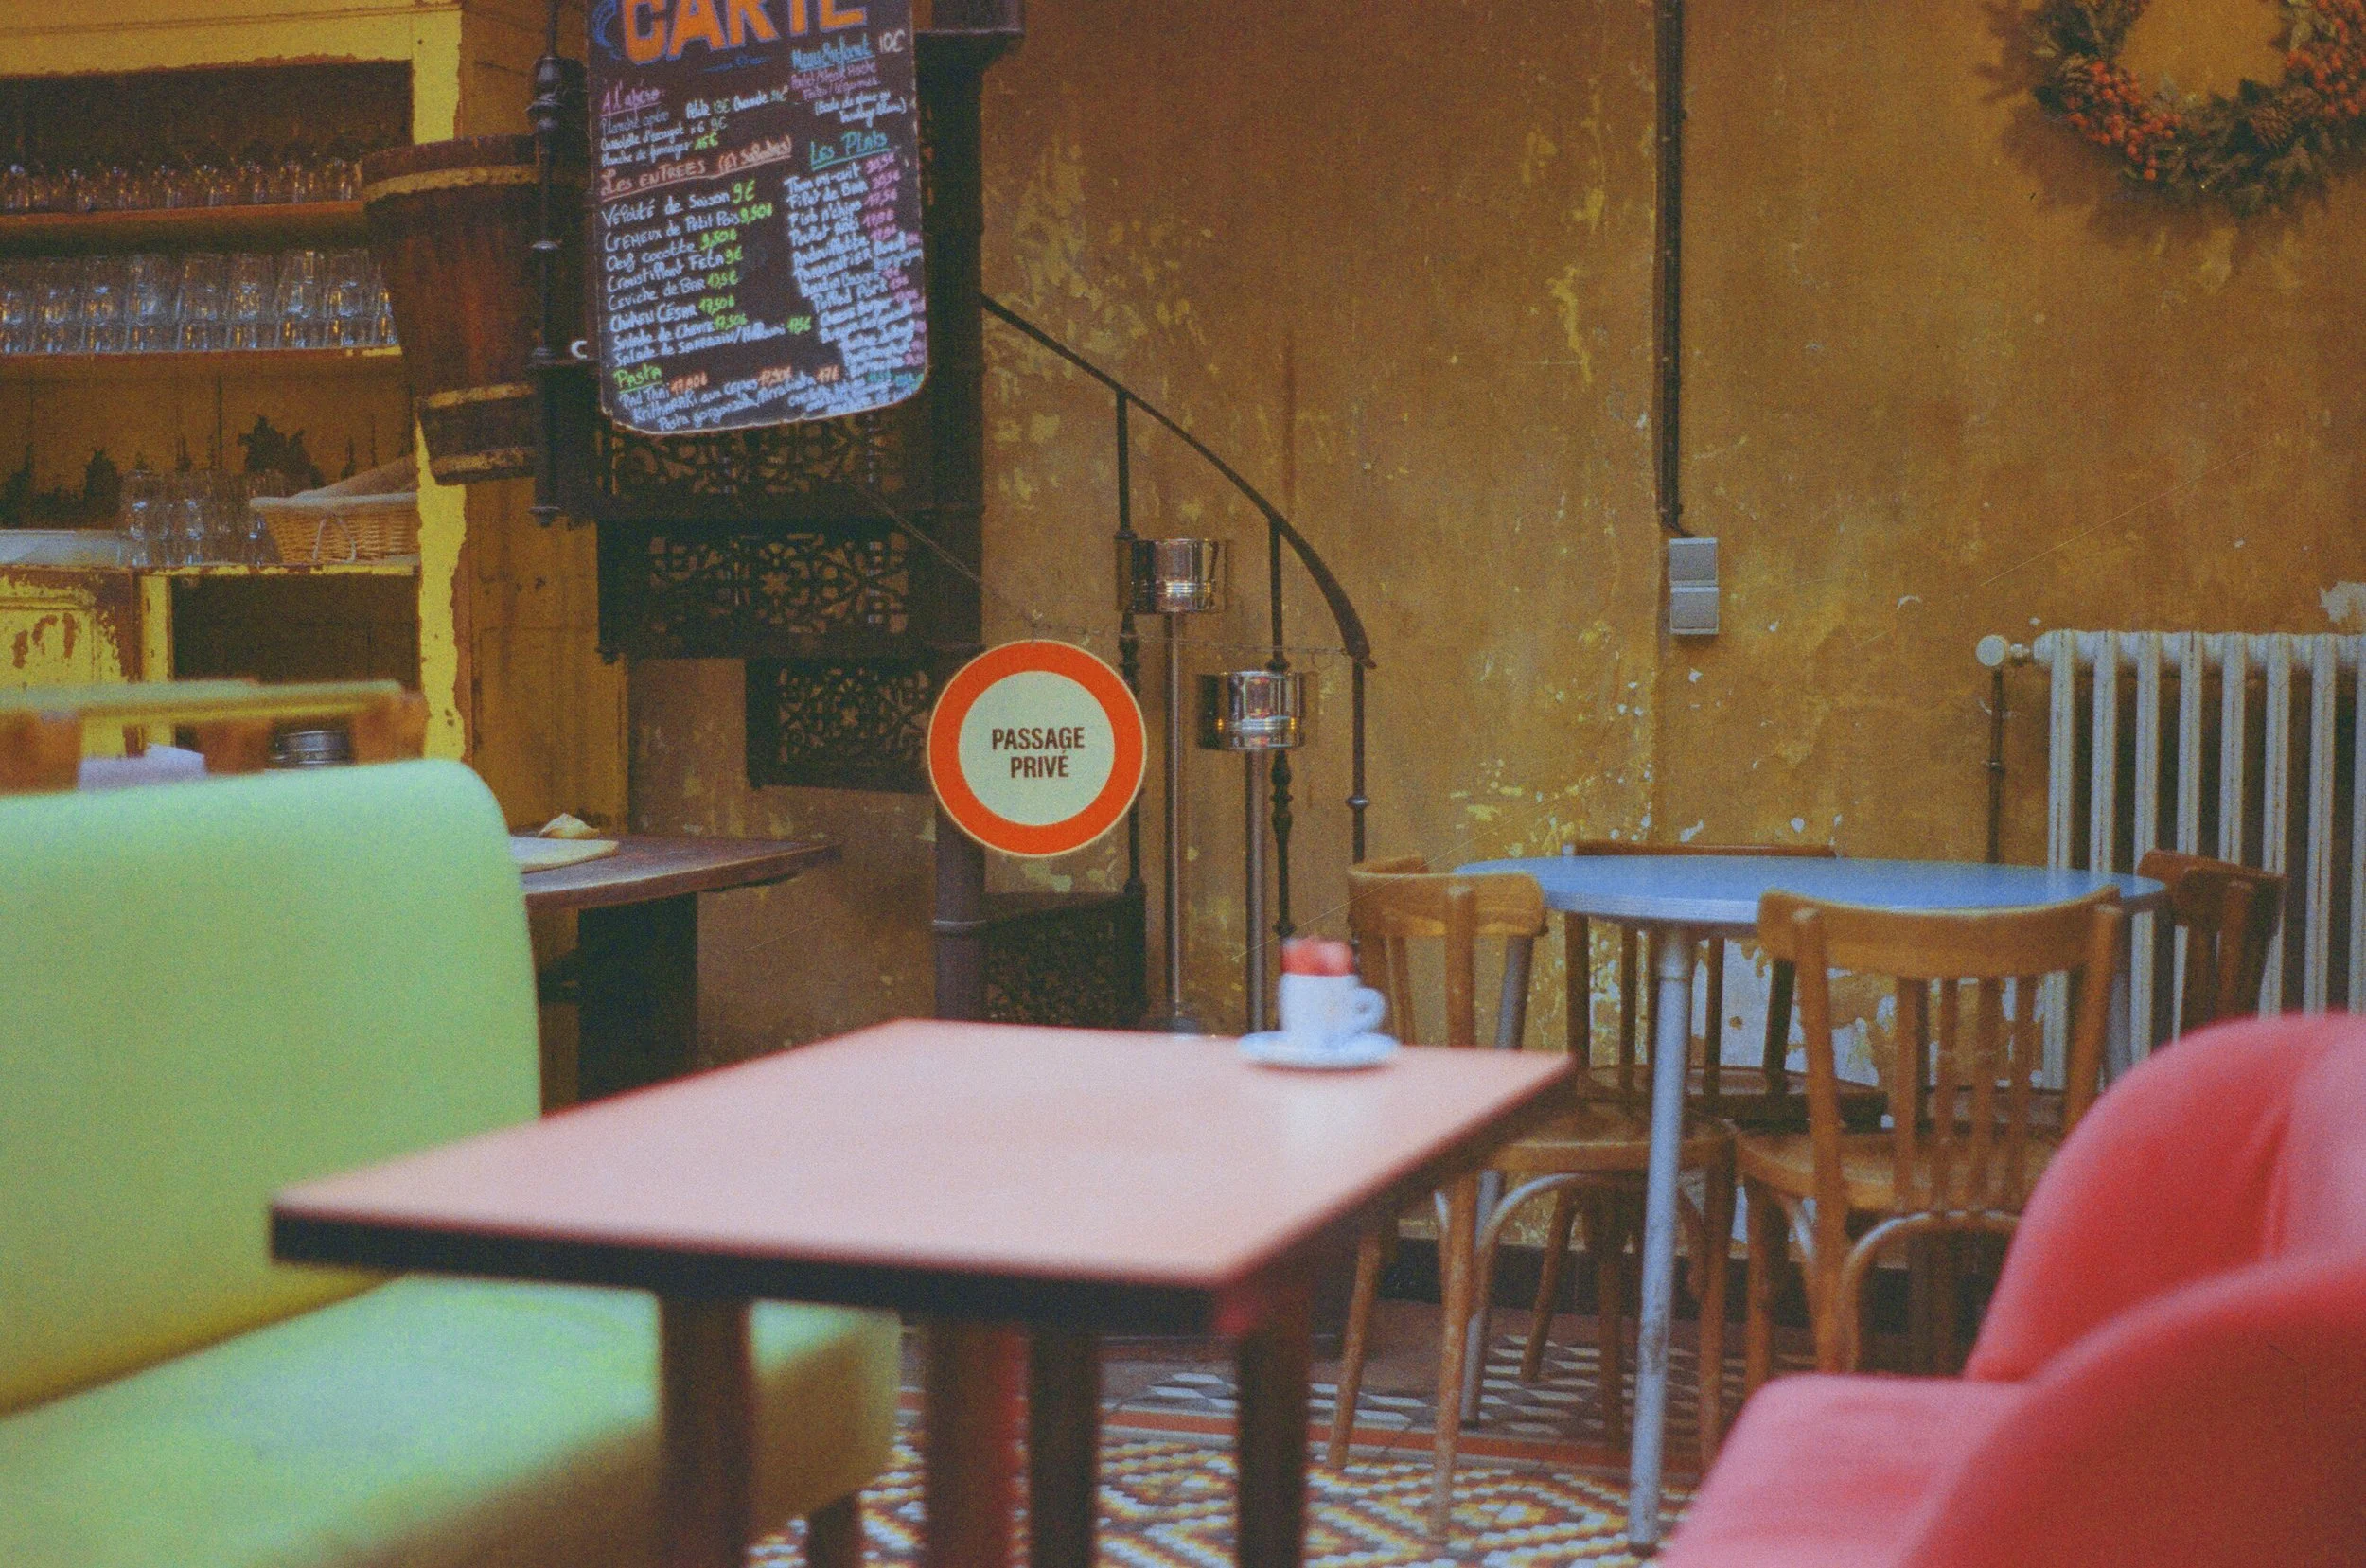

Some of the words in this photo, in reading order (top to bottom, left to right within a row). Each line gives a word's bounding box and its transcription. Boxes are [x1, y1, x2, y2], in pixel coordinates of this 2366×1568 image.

[664, 195, 683, 216] de
[689, 191, 731, 208] Saison
[733, 178, 756, 205] 9€
[665, 219, 682, 238] de
[641, 238, 696, 263] cocotte
[662, 281, 679, 298] de
[992, 726, 1086, 750] PASSAGE
[1010, 749, 1070, 779] PRIVÉ
